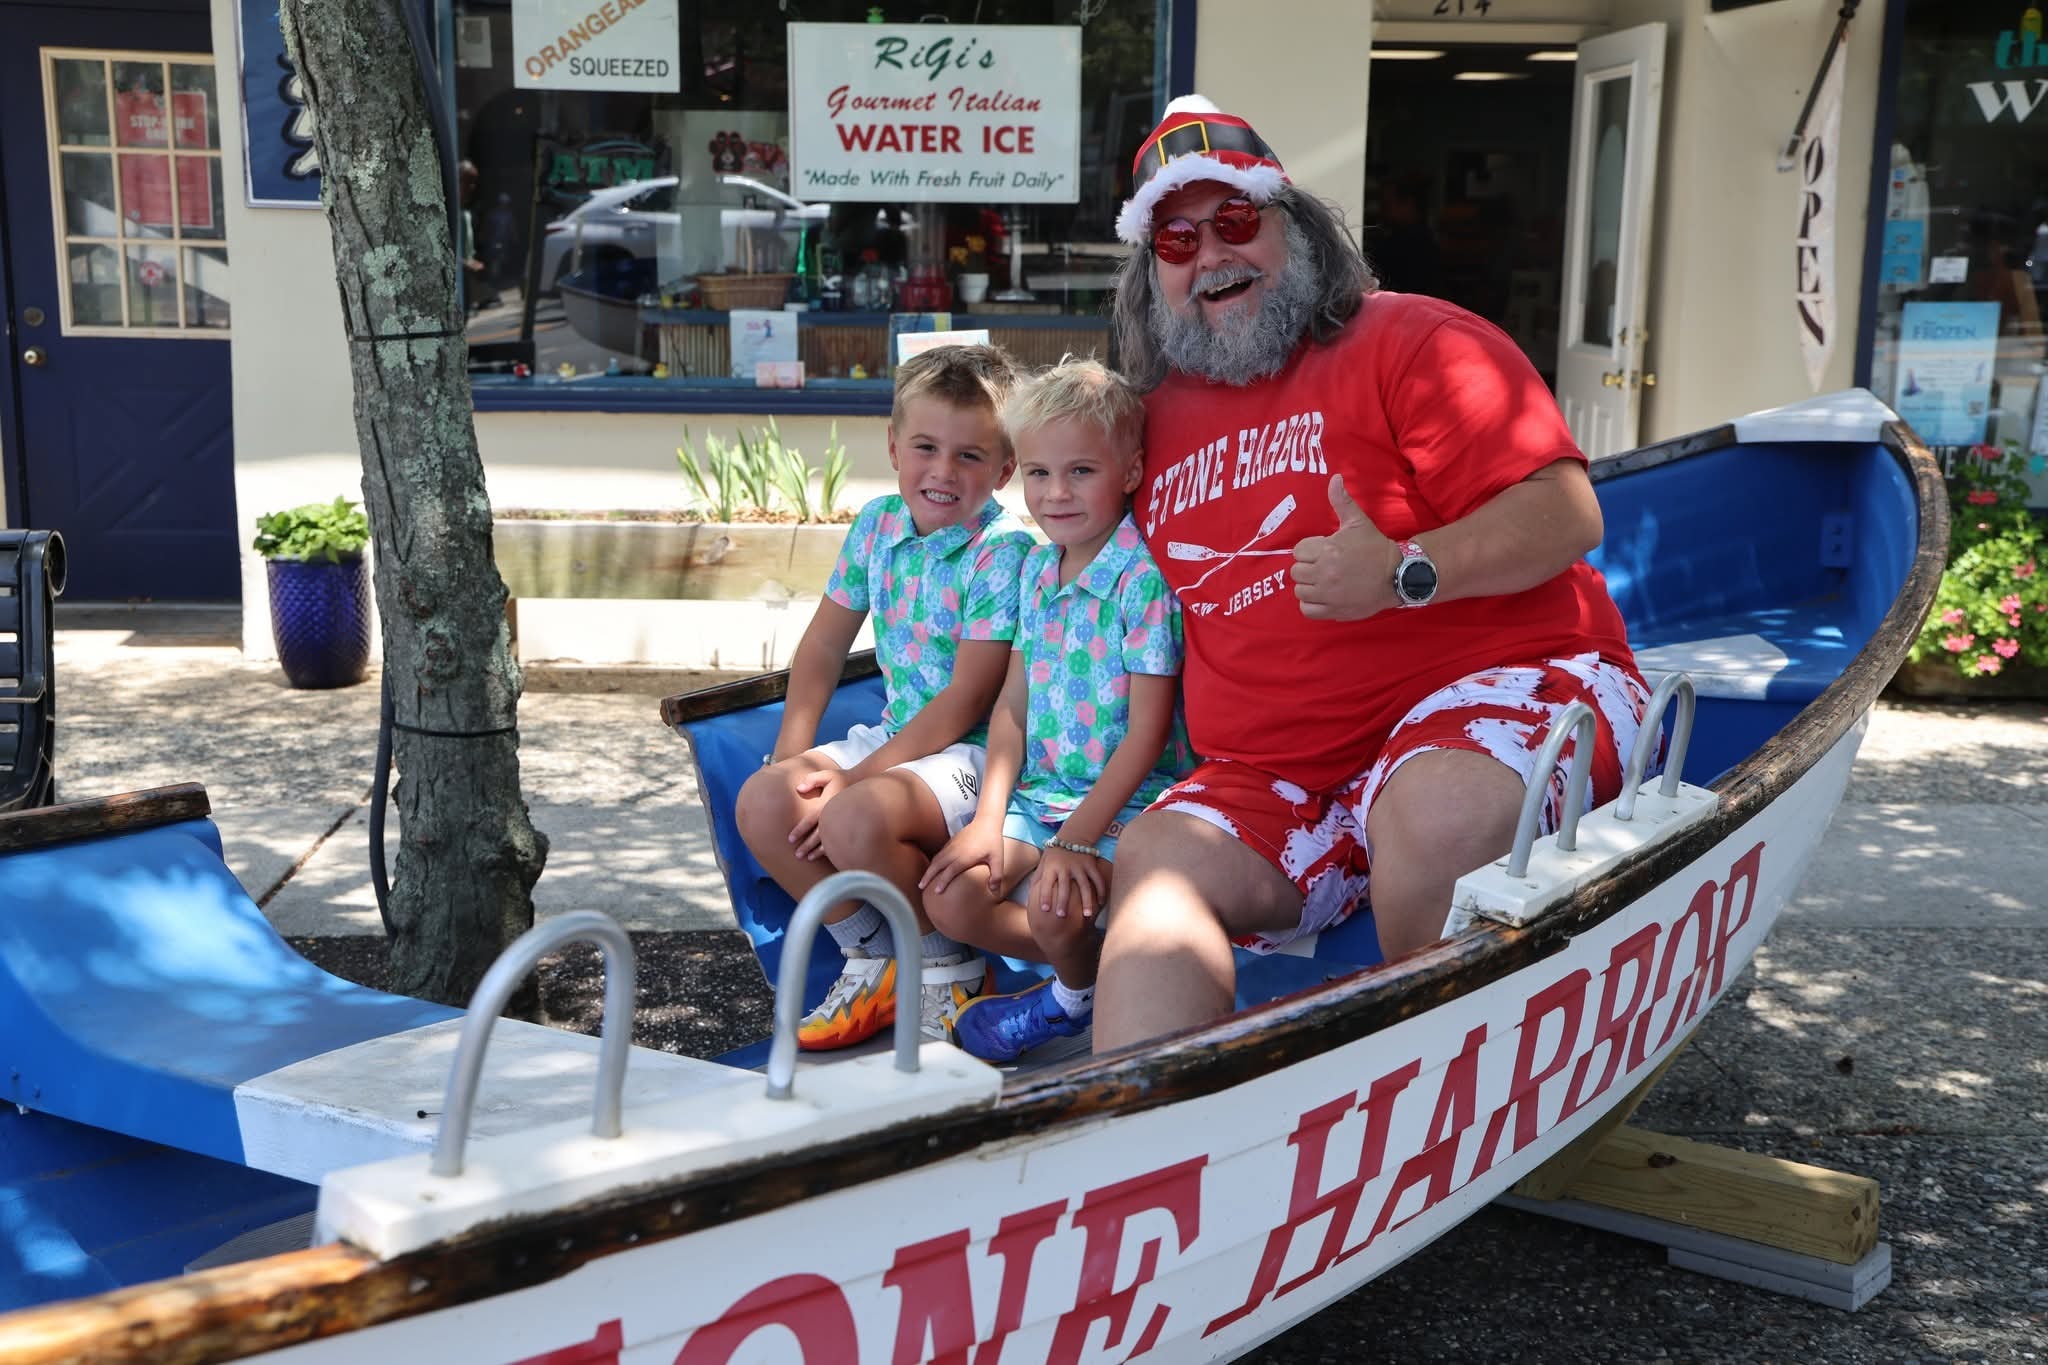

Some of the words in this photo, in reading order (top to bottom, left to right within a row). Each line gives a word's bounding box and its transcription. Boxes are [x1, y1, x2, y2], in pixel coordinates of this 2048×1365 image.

[525, 0, 647, 79] ORANGEA
[569, 57, 669, 77] SQUEEZED
[874, 37, 996, 81] RiGi's
[827, 85, 936, 118] Gourmet
[948, 87, 1042, 113] Italian
[836, 123, 963, 153] WATER
[983, 126, 1035, 154] ICE
[549, 153, 655, 187] ATM
[870, 170, 909, 188] With
[916, 170, 962, 188] Fresh
[968, 171, 1005, 188] Fruit
[1146, 435, 1229, 539] STONE
[1232, 411, 1328, 490] HARBOR
[1223, 568, 1286, 616] JERSEY
[951, 774, 969, 801] umbro
